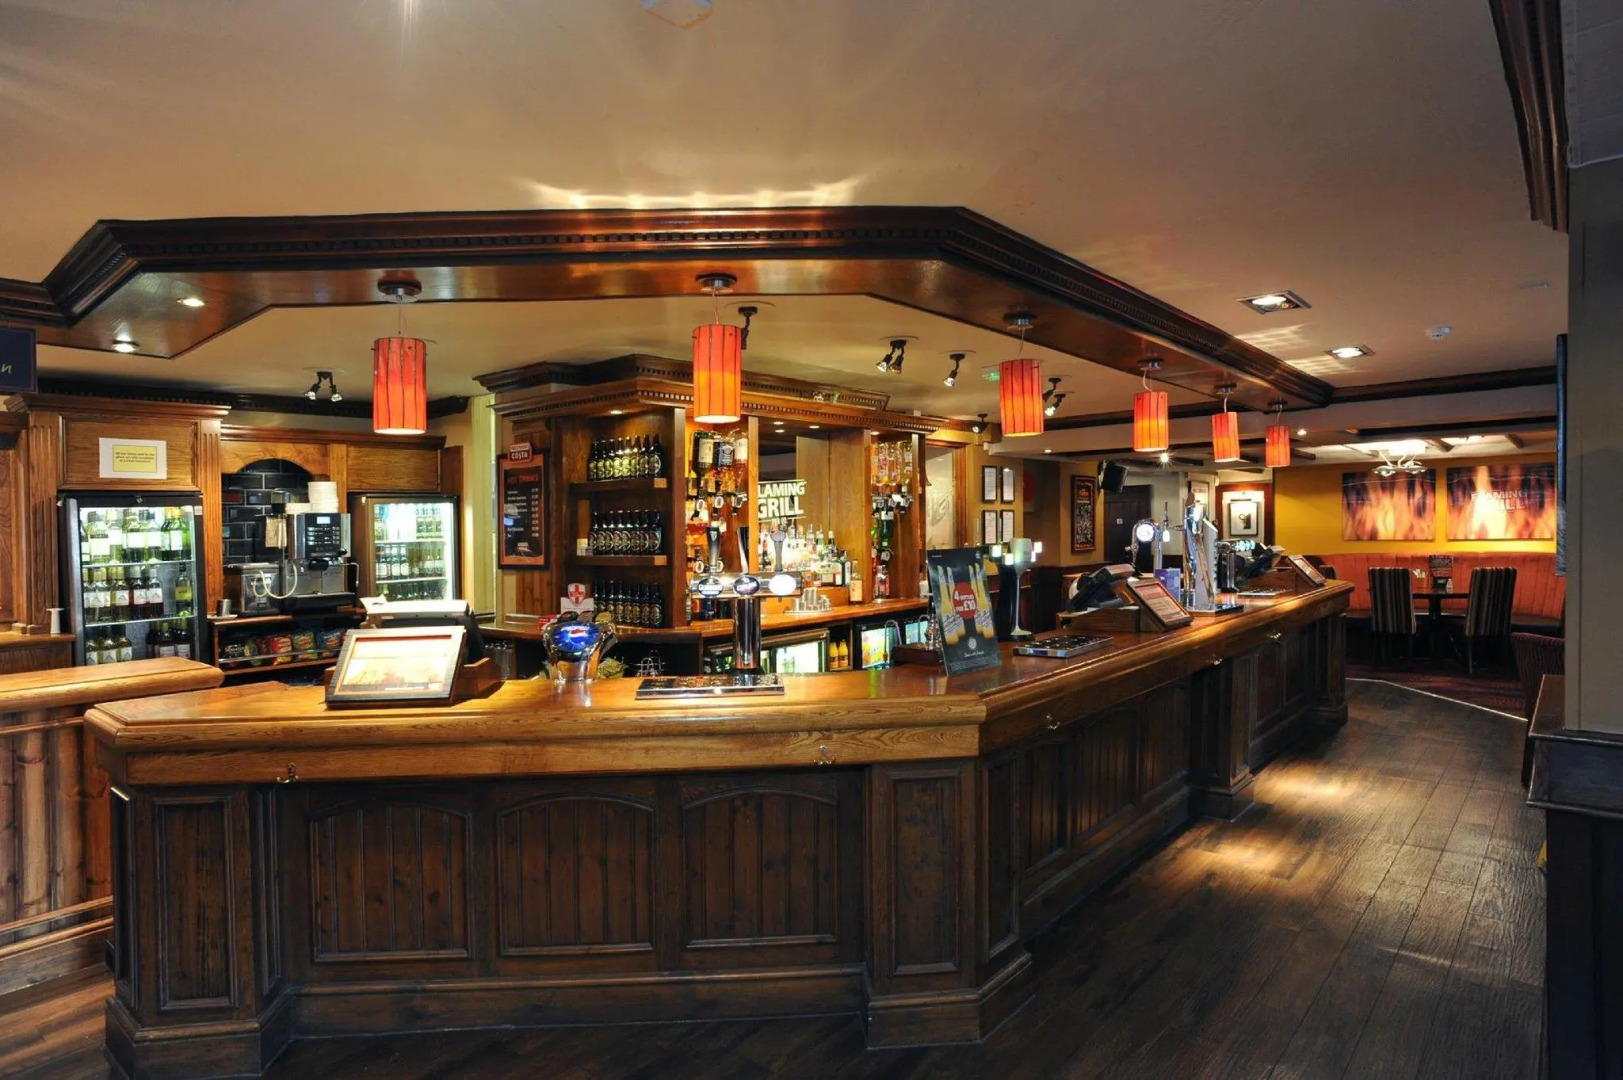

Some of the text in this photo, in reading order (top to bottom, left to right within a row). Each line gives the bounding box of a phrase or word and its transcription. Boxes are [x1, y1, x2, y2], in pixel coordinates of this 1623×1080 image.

[511, 451, 528, 460] COSTA
[758, 482, 806, 497] LAMING
[1471, 490, 1528, 501] FAMING
[758, 496, 804, 518] GRILL
[954, 590, 960, 601] 4
[963, 599, 976, 611] £10
